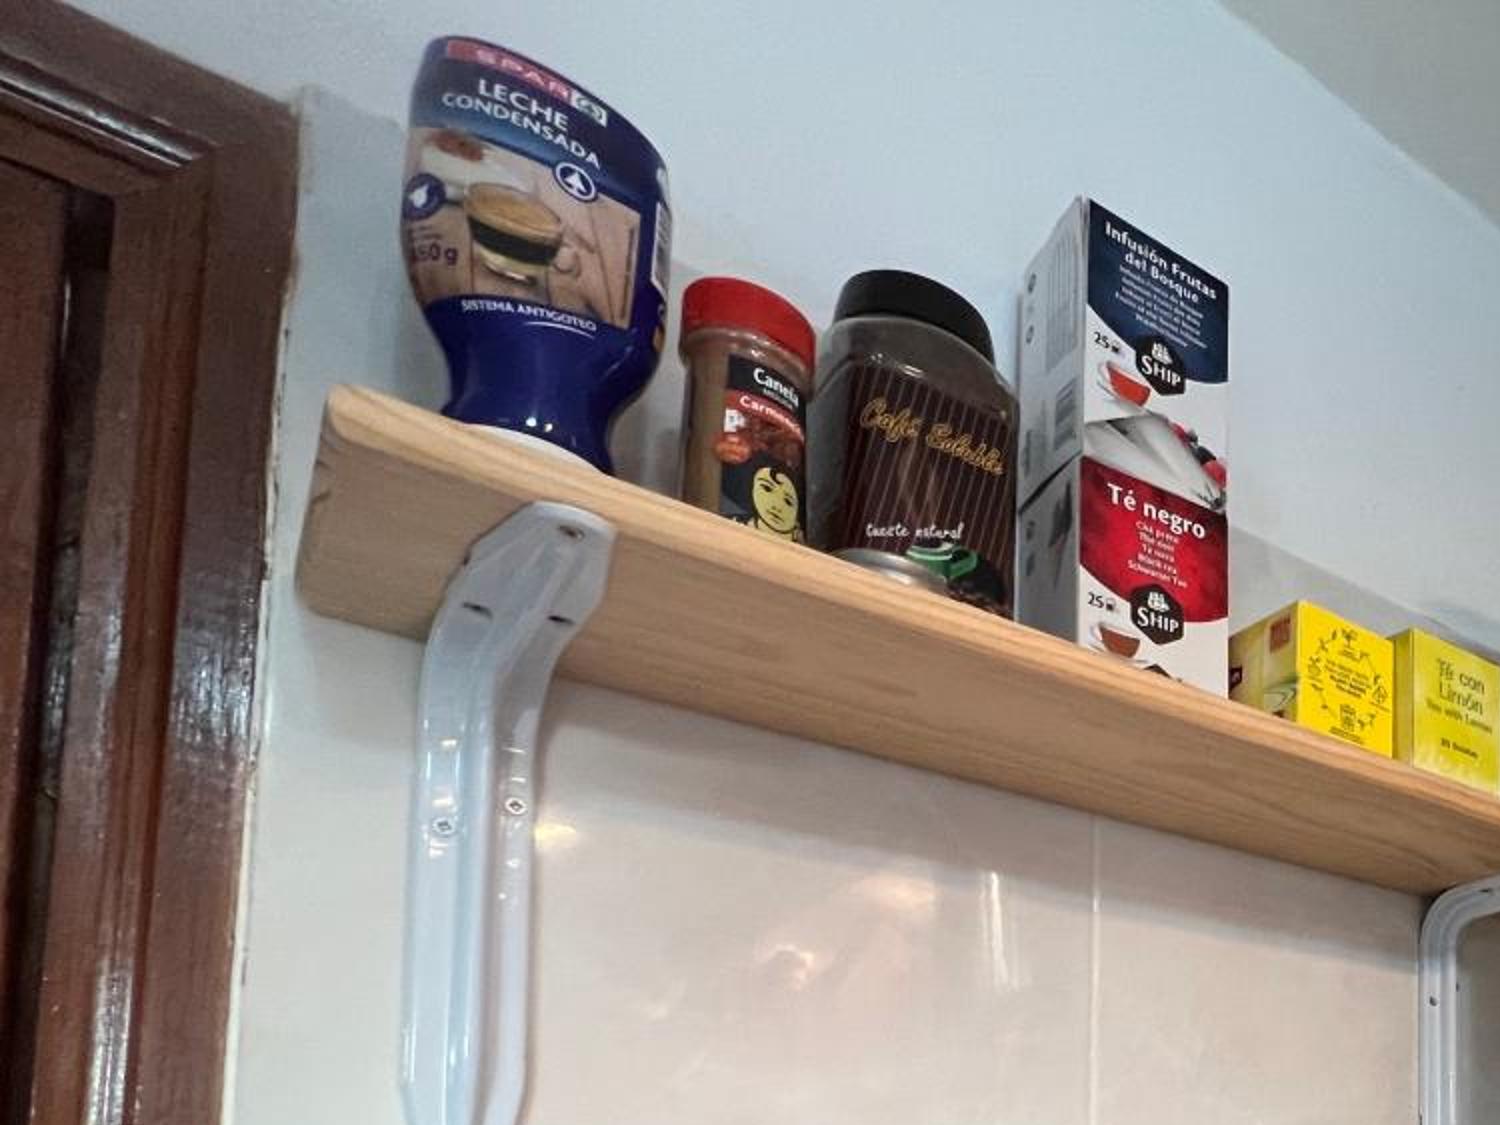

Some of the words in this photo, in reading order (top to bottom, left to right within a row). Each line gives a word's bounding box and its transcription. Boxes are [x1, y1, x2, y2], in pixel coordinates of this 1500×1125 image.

[479, 78, 568, 131] LECHE
[441, 92, 600, 168] CONDENSADA
[1104, 221, 1168, 271] Infusión
[1171, 263, 1217, 300] Frutas
[1125, 251, 1147, 273] del
[1151, 266, 1200, 303] Bosque
[460, 299, 514, 315] SISTEMA
[1094, 331, 1110, 349] 25
[753, 367, 799, 408] Canela
[1140, 355, 1182, 387] SHIP
[1106, 483, 1137, 511] Té
[1143, 504, 1206, 539] negro
[1087, 592, 1105, 609] 25
[1136, 607, 1180, 634] SHIP
[1439, 681, 1484, 716] Limón
[1459, 673, 1485, 695] con
